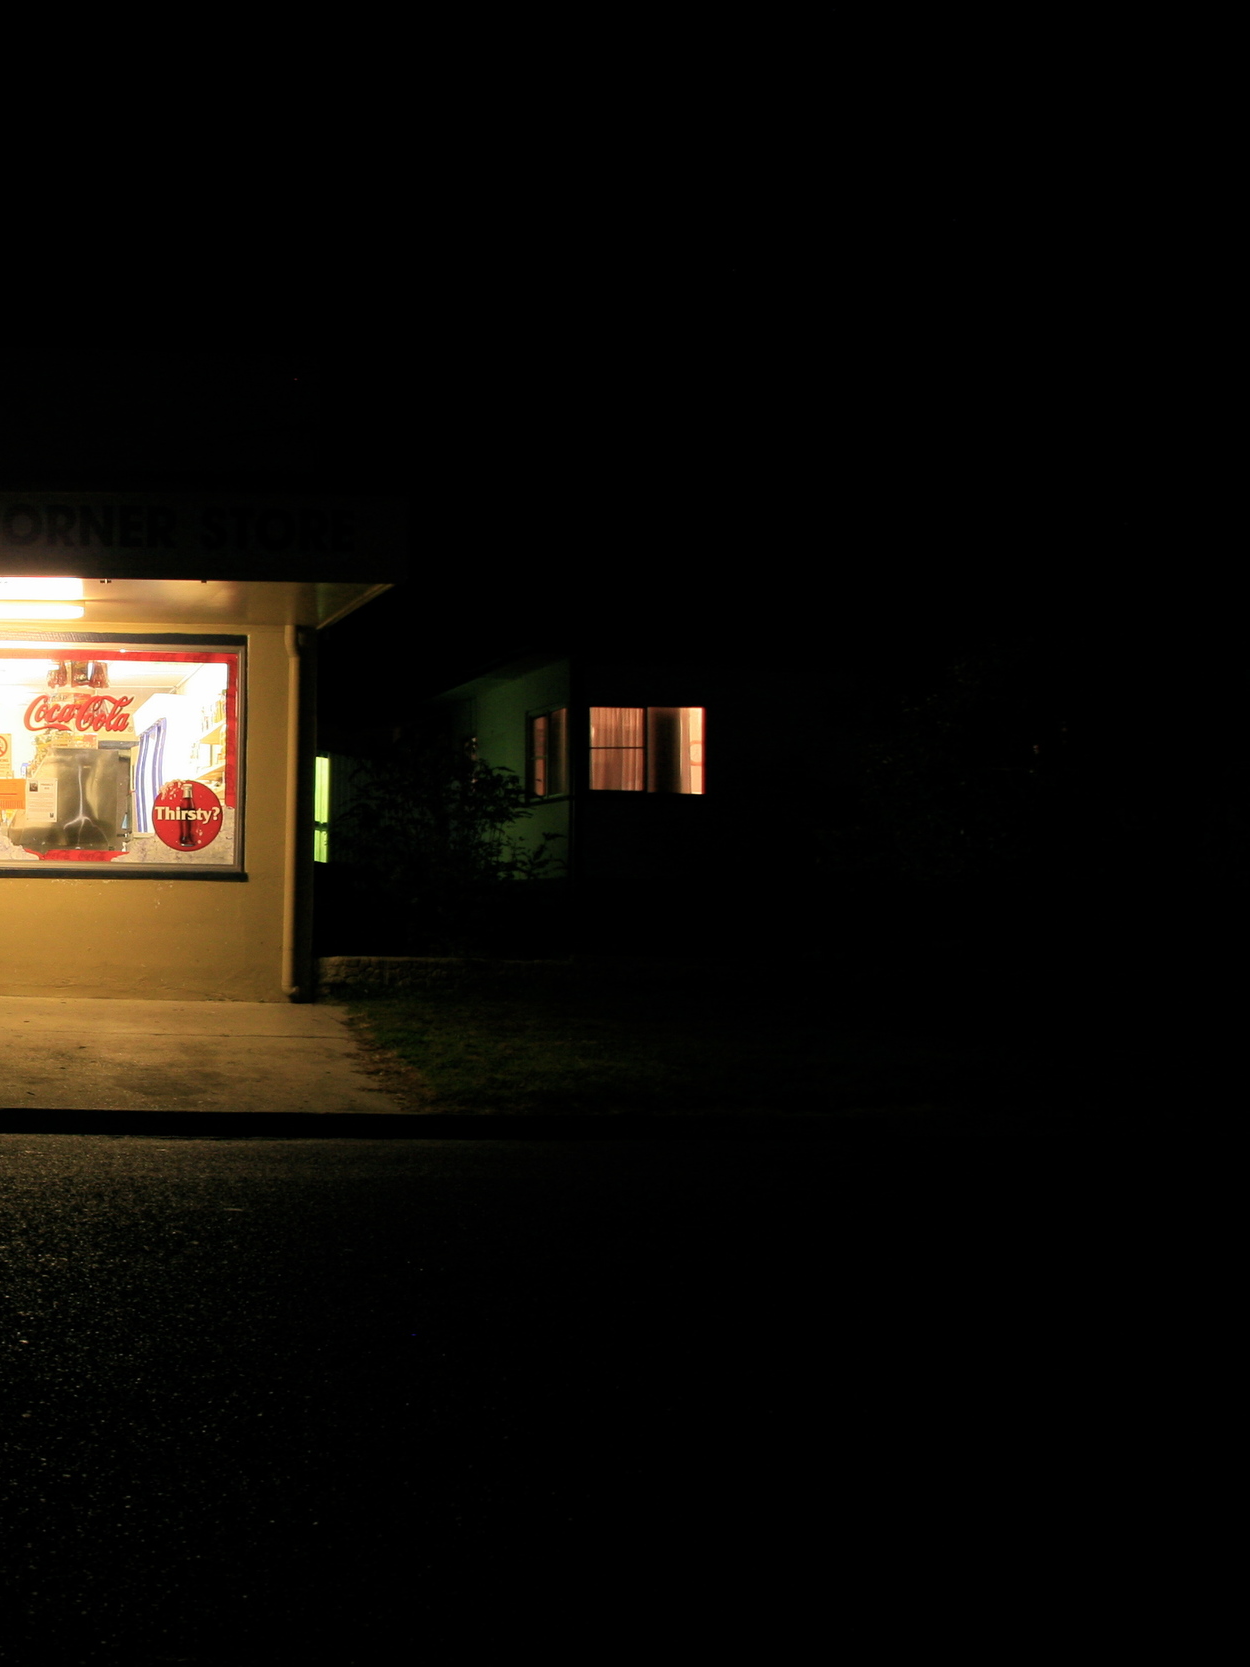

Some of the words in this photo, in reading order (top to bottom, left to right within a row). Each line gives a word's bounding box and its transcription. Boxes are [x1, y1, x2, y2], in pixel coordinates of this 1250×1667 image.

[201, 506, 356, 552] STORE
[24, 694, 134, 732] Coca-Cola
[155, 806, 221, 824] Thirsty?
